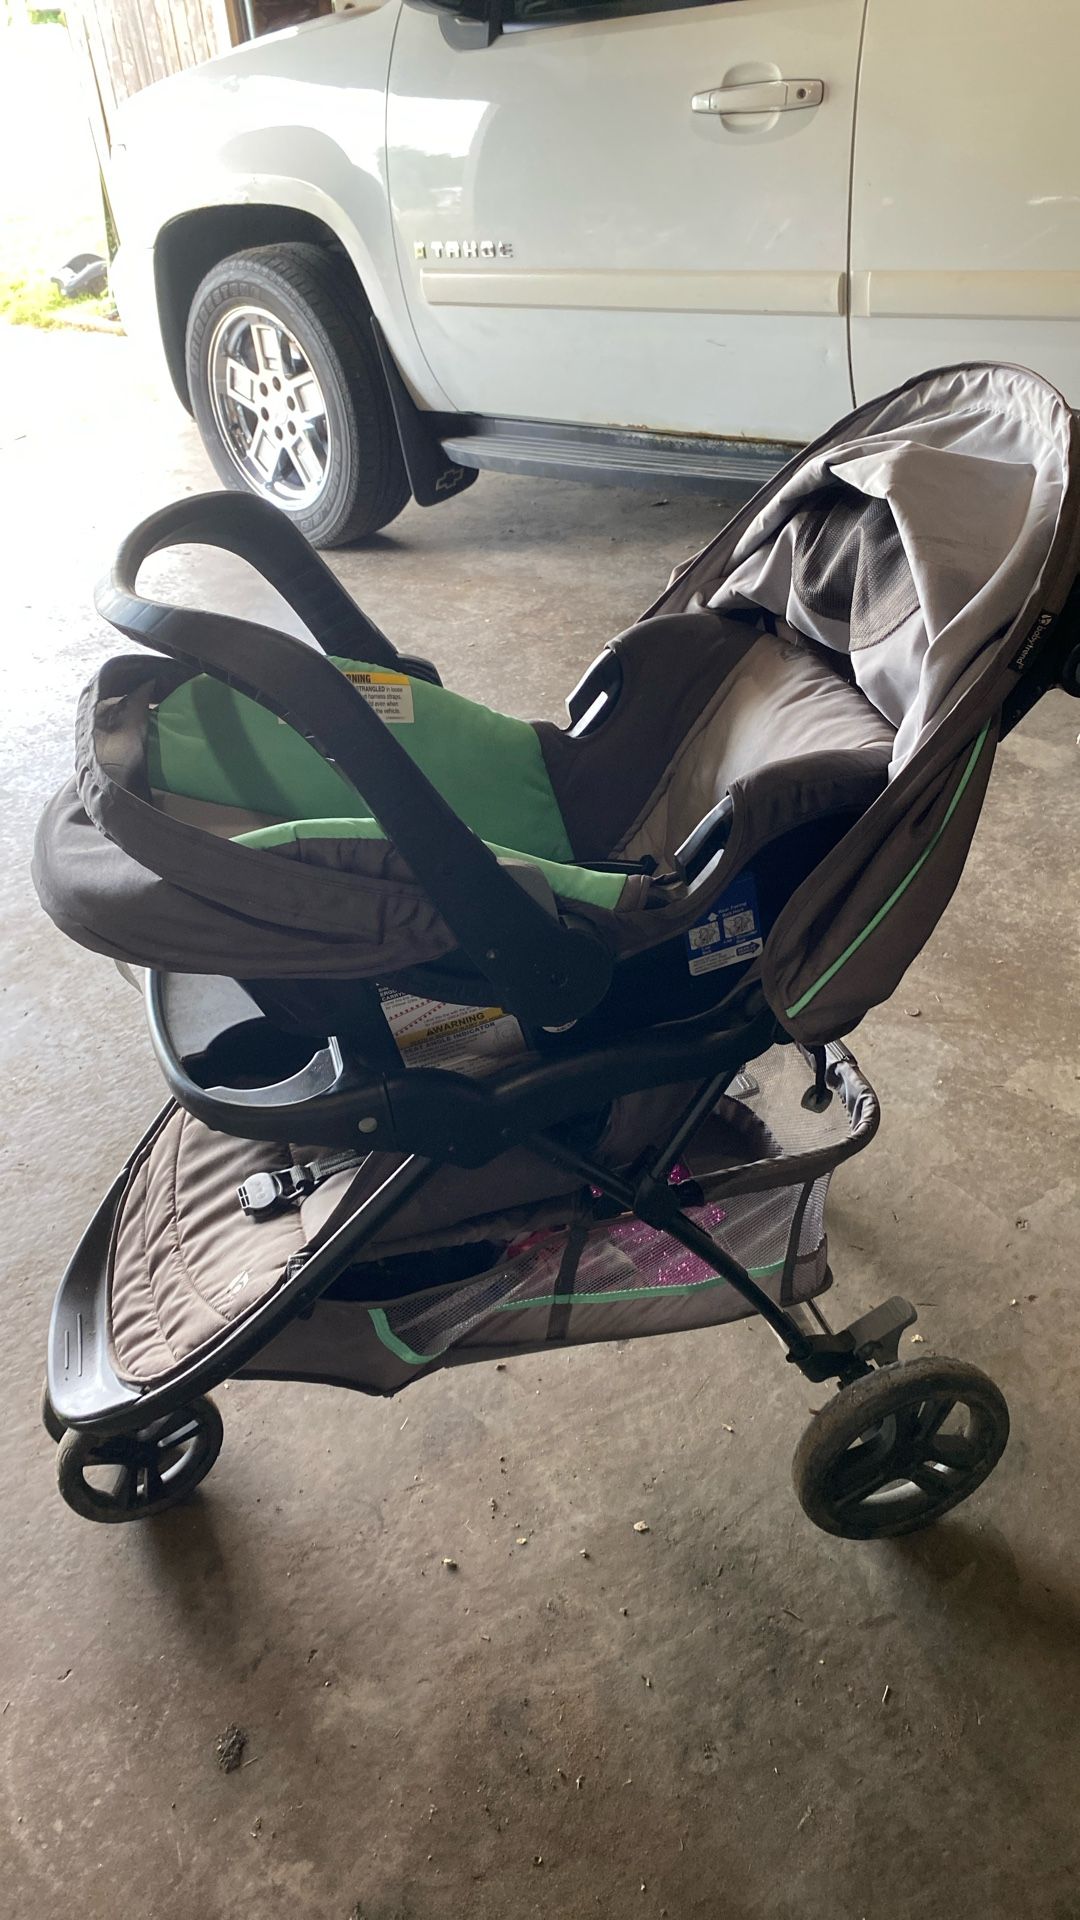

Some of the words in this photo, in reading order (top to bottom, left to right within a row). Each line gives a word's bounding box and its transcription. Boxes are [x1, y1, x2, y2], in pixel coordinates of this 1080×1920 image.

[430, 240, 512, 258] TAHOE
[345, 674, 371, 684] RNING
[431, 1012, 485, 1034] WARNING
[453, 1021, 495, 1039] INDICATOR
